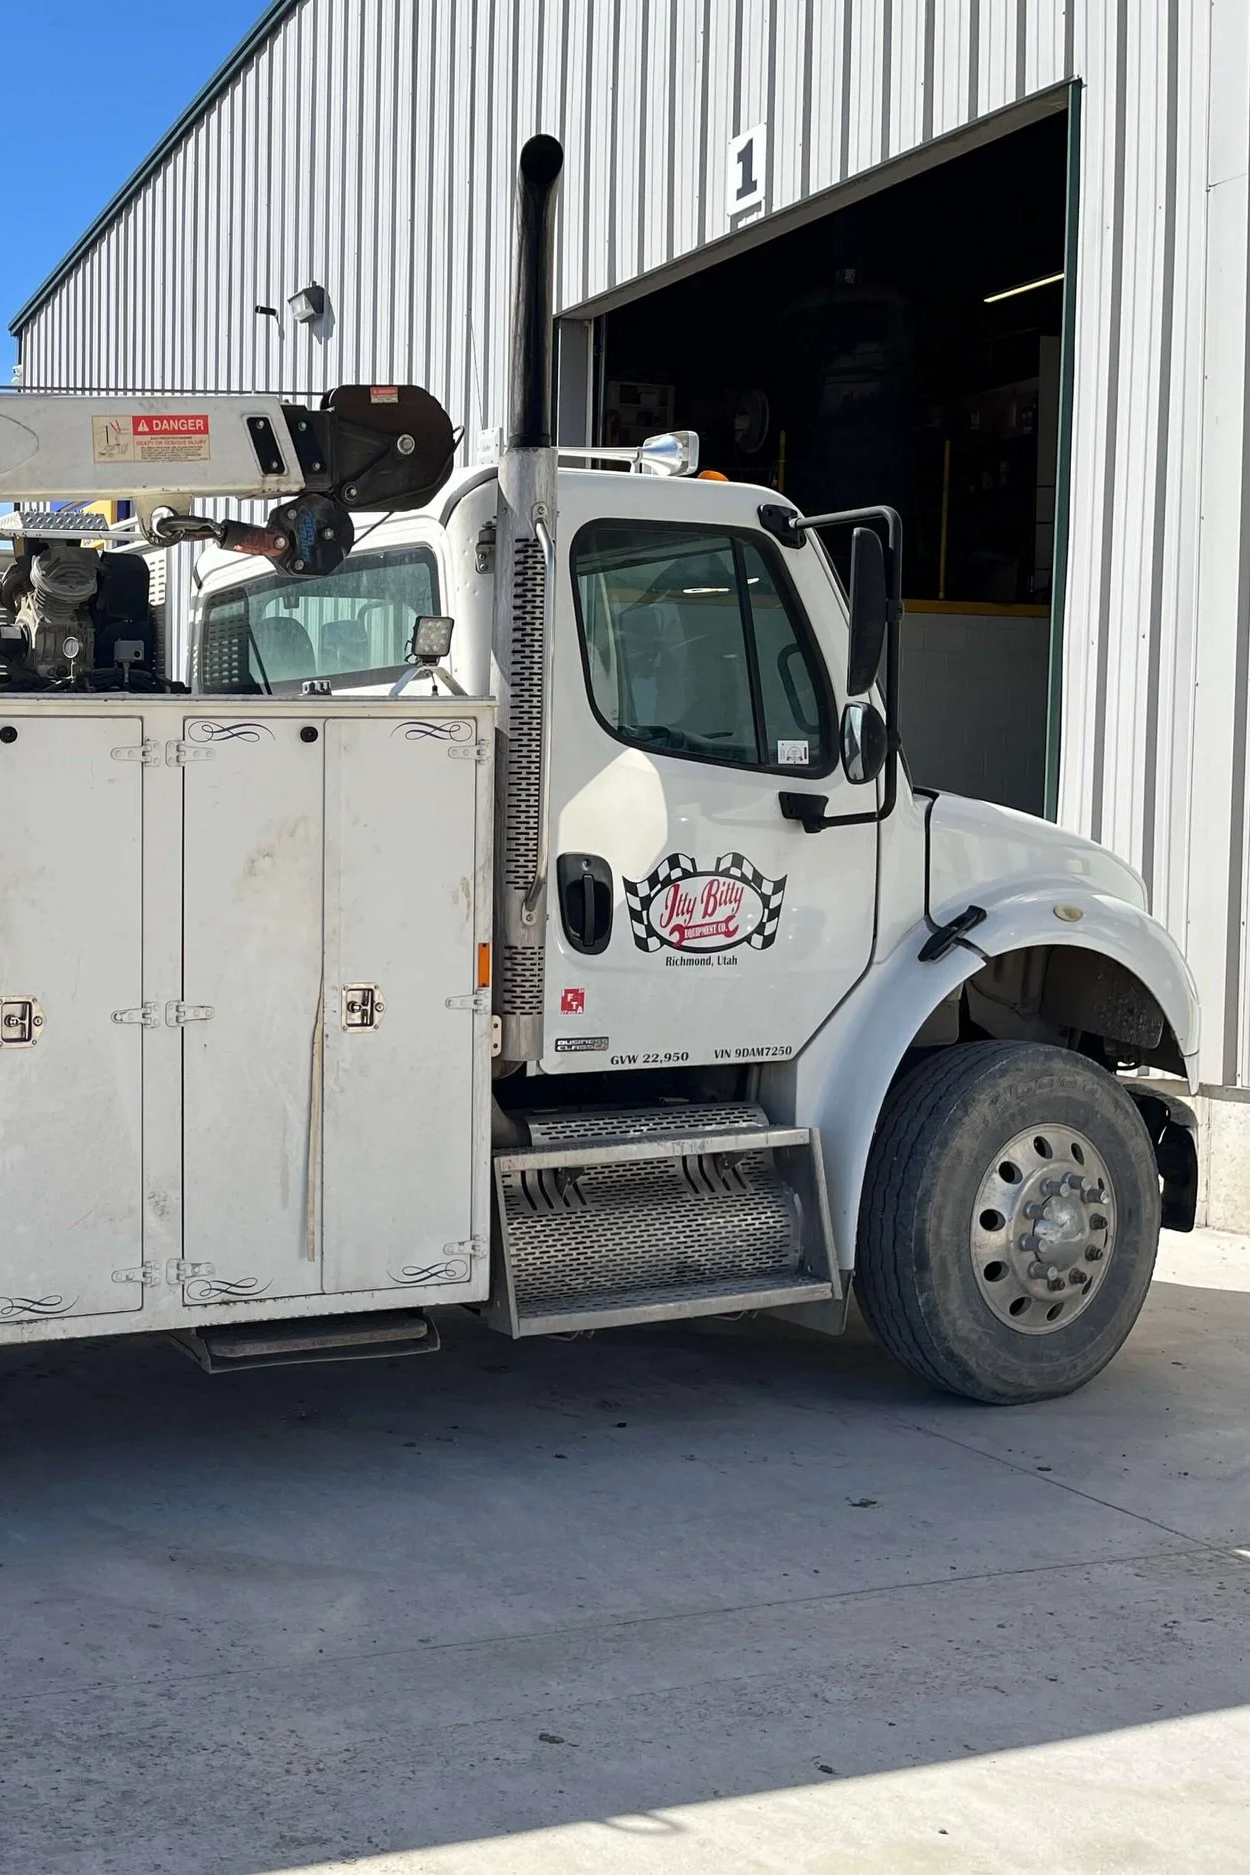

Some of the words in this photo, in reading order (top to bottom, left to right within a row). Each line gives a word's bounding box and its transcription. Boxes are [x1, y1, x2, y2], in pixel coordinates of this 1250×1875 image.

[735, 138, 757, 201] 1
[152, 419, 204, 431] DANGER
[659, 883, 697, 928] Itty
[700, 879, 745, 919] Bitty
[684, 924, 717, 938] EQUIPMENT
[665, 956, 714, 967] Richmond,
[717, 955, 738, 966] Utah
[610, 1055, 638, 1065] GVW
[642, 1052, 689, 1064] 22,950
[714, 1049, 732, 1059] VIN
[735, 1046, 793, 1058] 9DAM7250
